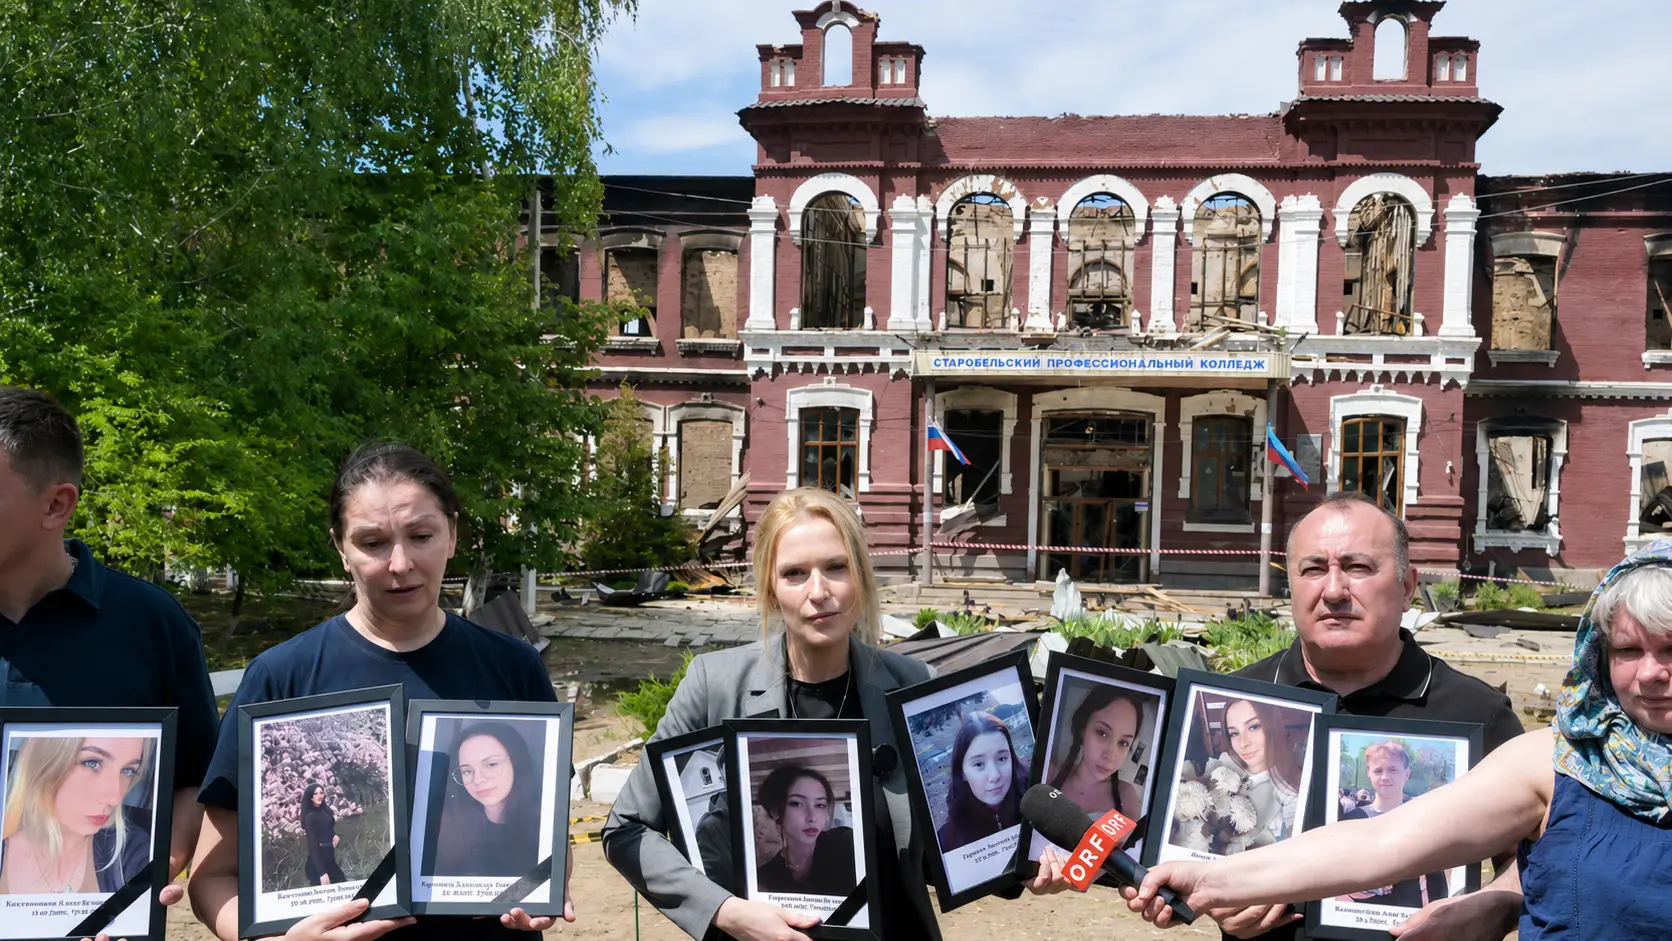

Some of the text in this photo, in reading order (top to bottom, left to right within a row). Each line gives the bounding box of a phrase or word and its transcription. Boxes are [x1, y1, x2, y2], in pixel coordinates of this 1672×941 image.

[933, 357, 1265, 371] СТАРОБЕЛЬСКИЙ ПРОФЕССИОНАЛЬНЫЙ КОЛЛЕДЖ
[1100, 813, 1129, 836] ORF
[1069, 832, 1105, 882] ORF
